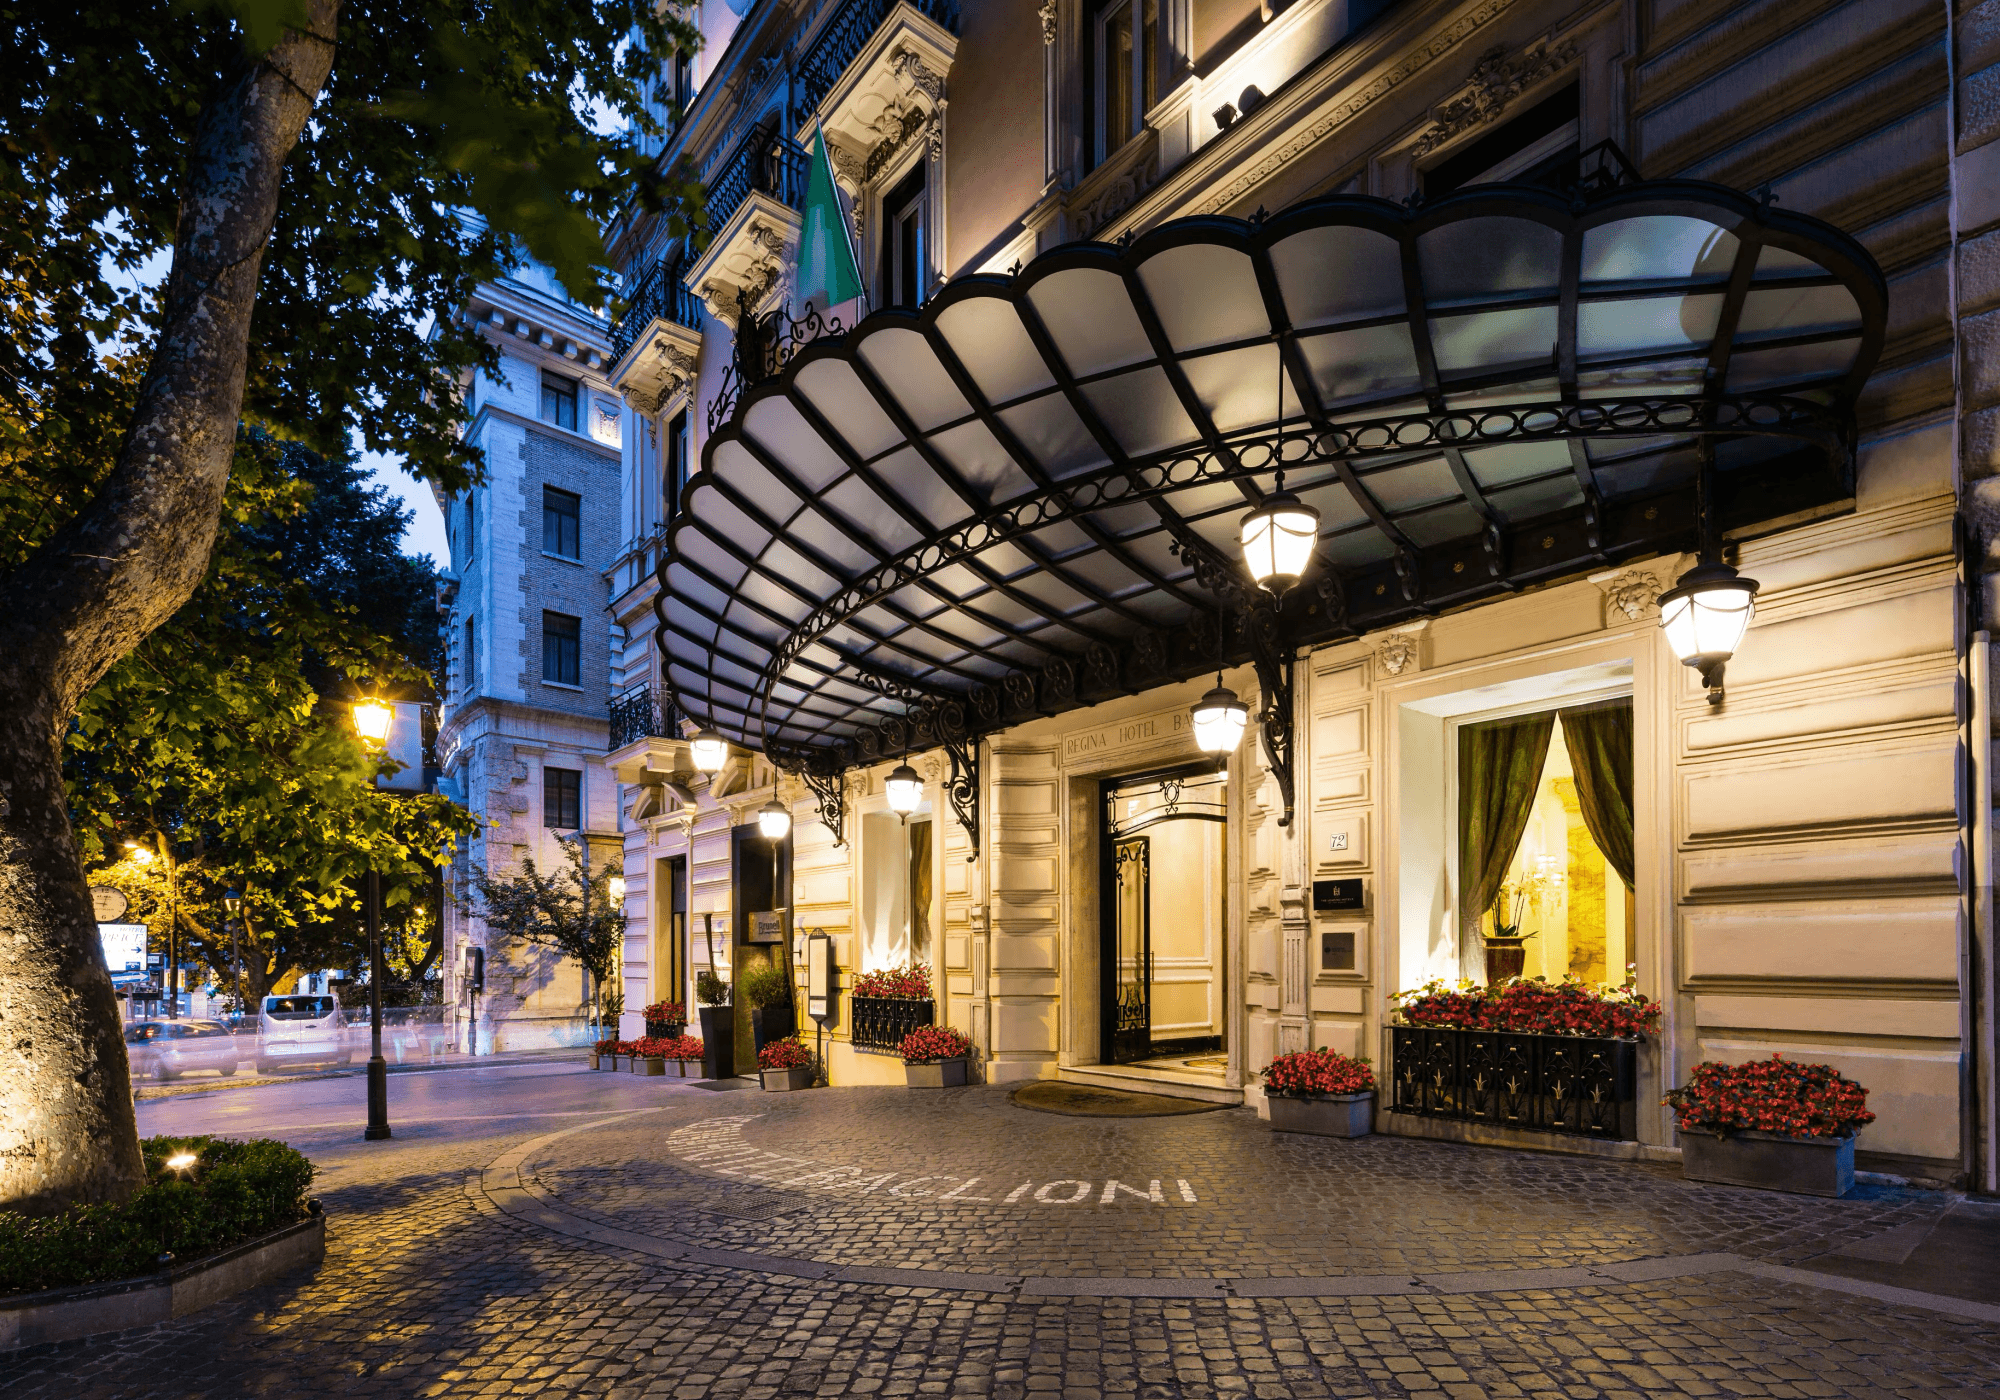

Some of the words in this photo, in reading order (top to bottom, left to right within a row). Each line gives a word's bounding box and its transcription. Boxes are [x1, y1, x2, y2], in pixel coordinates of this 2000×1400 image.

[1067, 733, 1106, 755] REGINA
[1119, 720, 1159, 743] HOTEL
[1331, 834, 1345, 848] 72
[669, 1140, 816, 1180] HOTEL
[780, 1165, 1198, 1203] BAGLIONI
